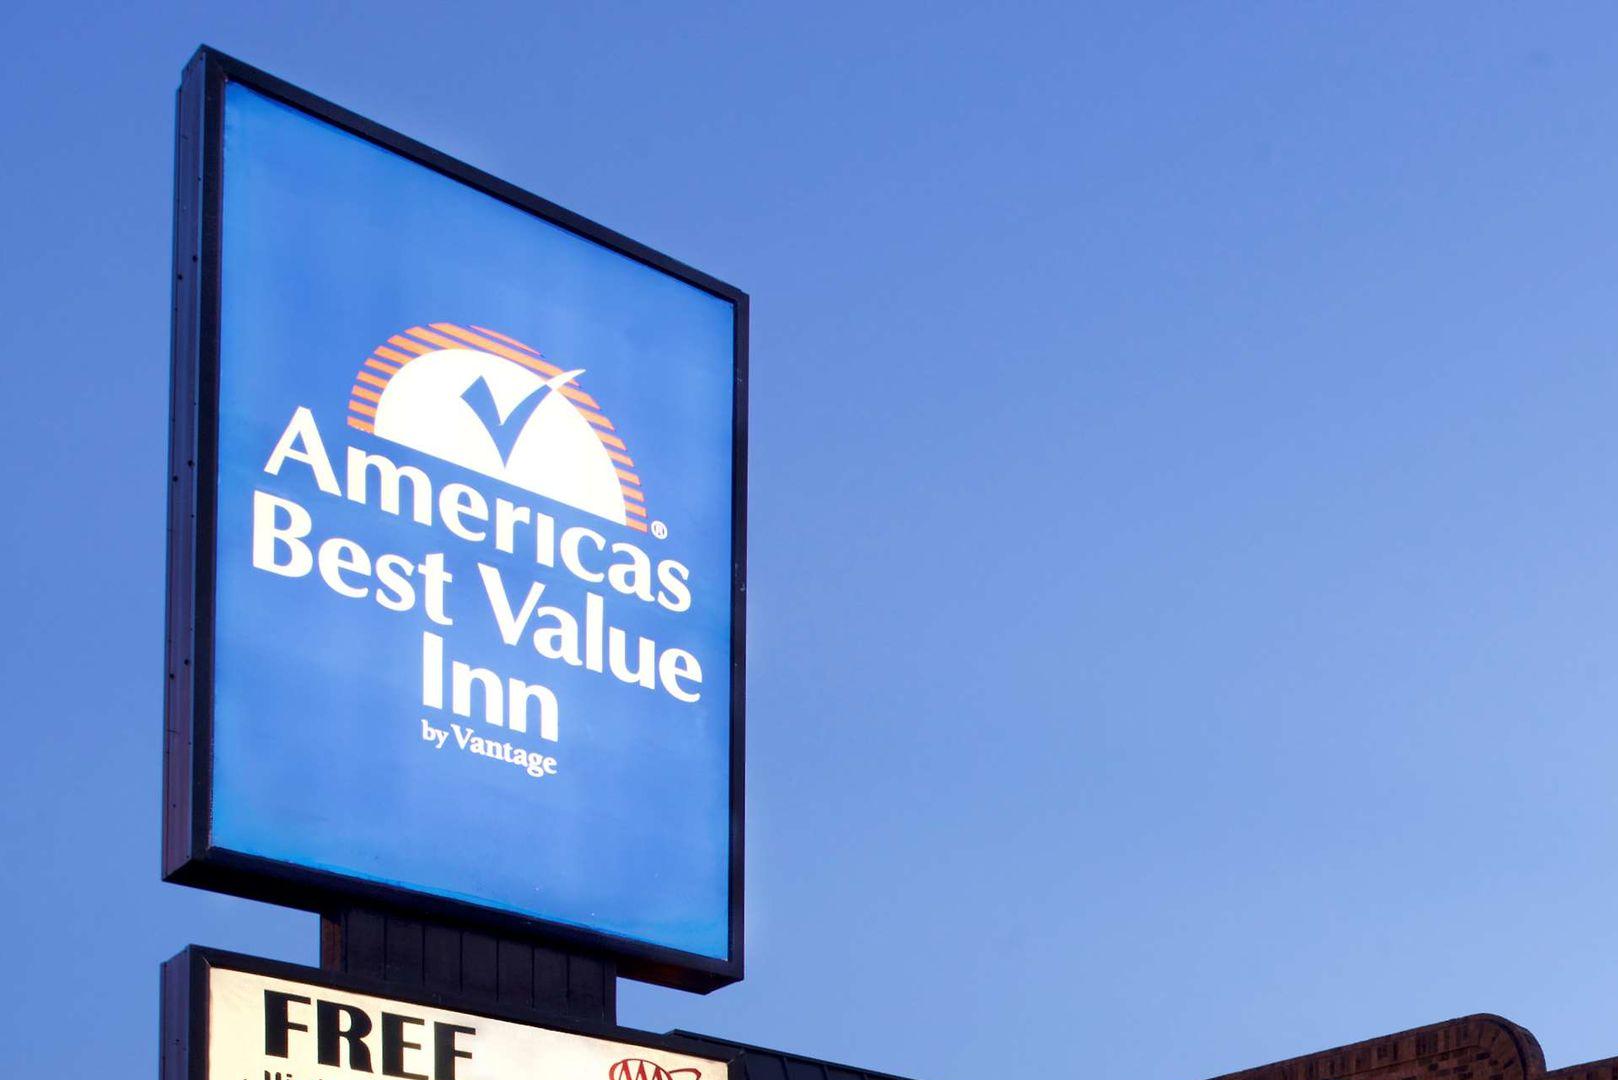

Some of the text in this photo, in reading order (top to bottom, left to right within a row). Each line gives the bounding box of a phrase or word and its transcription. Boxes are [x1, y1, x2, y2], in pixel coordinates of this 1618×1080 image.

[264, 407, 691, 612] Americas
[253, 490, 703, 703] Best Value
[422, 631, 558, 742] Inn
[422, 720, 557, 777] by Vantage
